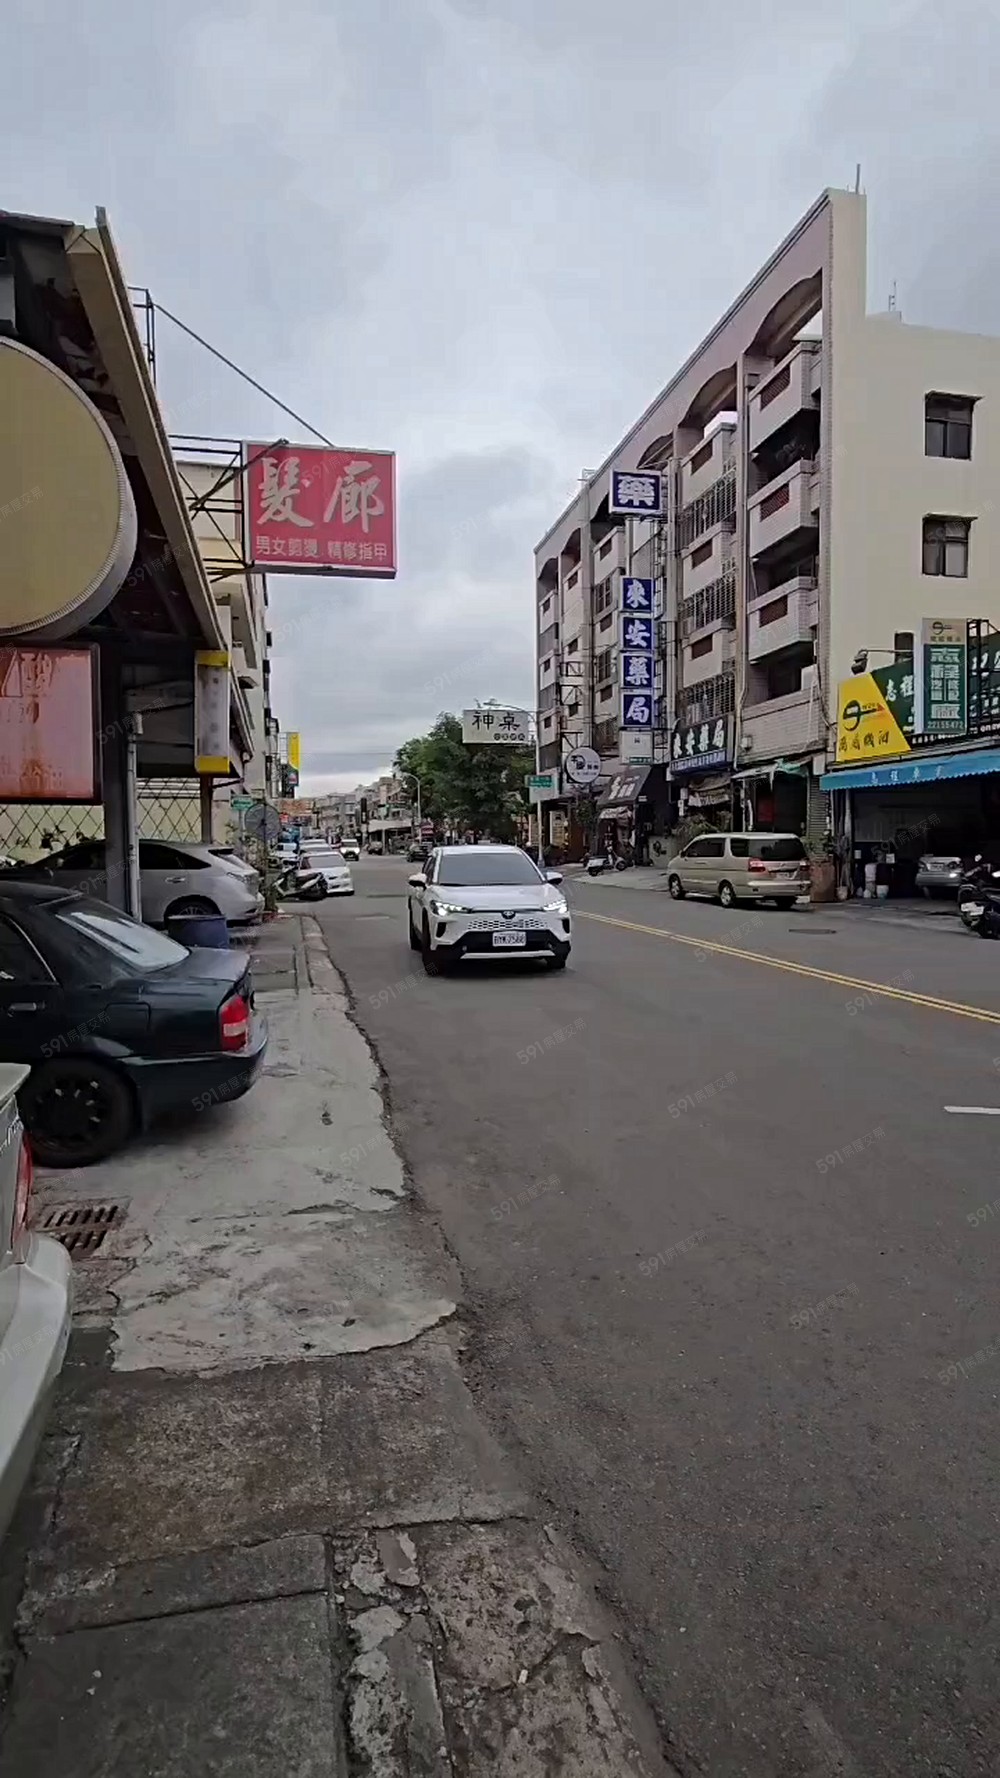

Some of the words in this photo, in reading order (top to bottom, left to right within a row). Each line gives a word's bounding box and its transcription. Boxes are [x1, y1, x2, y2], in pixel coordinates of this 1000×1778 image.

[257, 456, 385, 534] 髮廊
[617, 474, 657, 507] 藥
[327, 541, 388, 561] 精修指甲
[471, 710, 521, 731] 神桌
